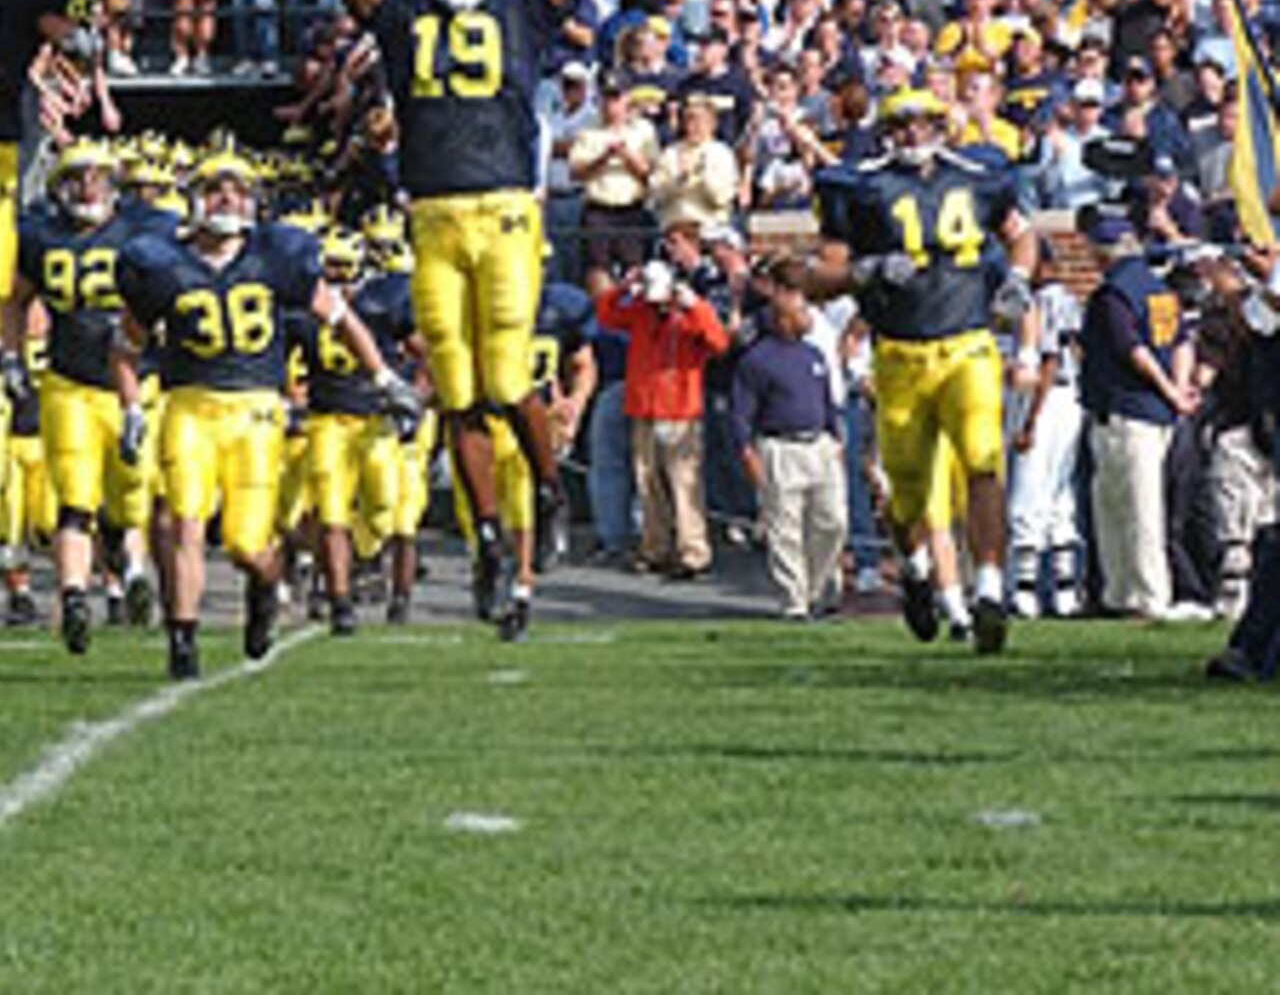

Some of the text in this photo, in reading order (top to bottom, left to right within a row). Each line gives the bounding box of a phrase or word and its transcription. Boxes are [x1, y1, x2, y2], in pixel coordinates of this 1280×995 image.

[411, 11, 504, 98] 19
[891, 187, 985, 268] 14
[43, 248, 122, 312] 92
[175, 282, 274, 358] 38
